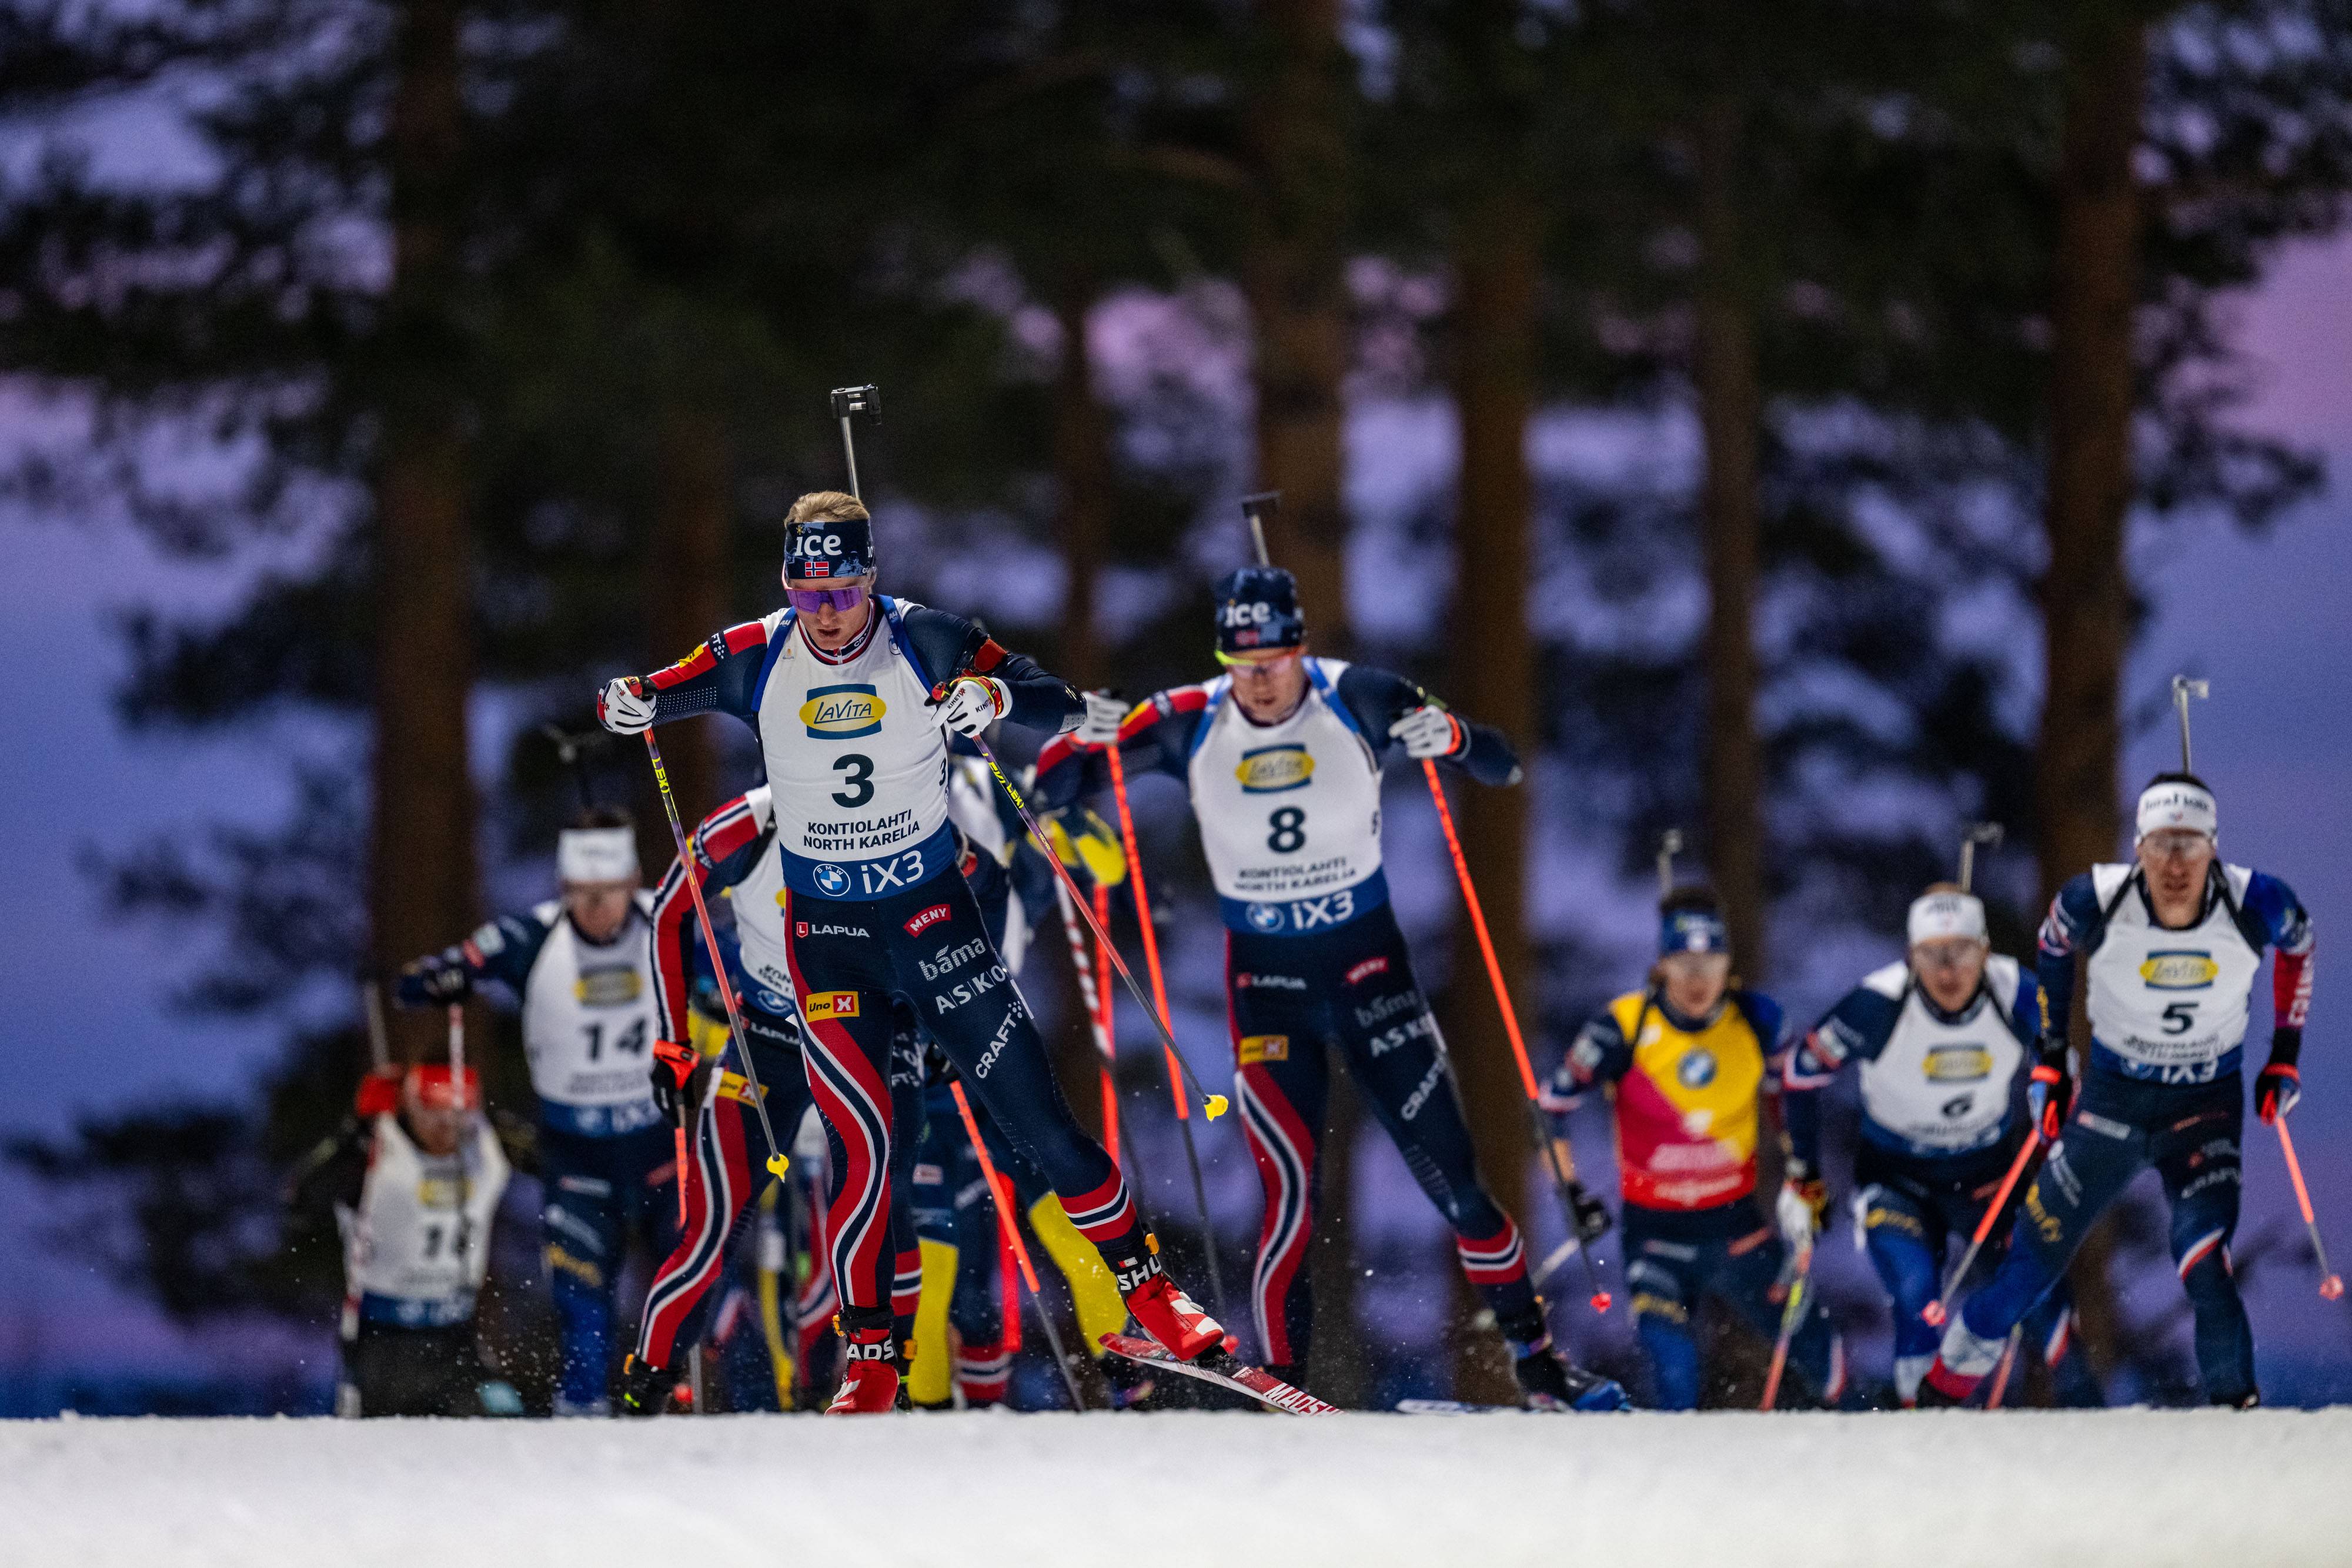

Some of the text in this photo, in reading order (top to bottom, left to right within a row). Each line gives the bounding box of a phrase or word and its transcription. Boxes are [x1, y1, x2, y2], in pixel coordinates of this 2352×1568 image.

[794, 534, 843, 556] ice
[1224, 601, 1271, 628] ice
[831, 753, 874, 808] 3
[803, 820, 921, 851] NORTH KARELIA
[807, 808, 912, 835] KONTIOLAHTI
[1267, 805, 1307, 854] 8
[860, 850, 924, 894] iX3
[811, 924, 870, 938] LAPUA
[910, 907, 947, 932] MENY
[809, 1002, 831, 1012] Uno
[2161, 1001, 2200, 1036] 5
[975, 1012, 1017, 1079] CRAFT
